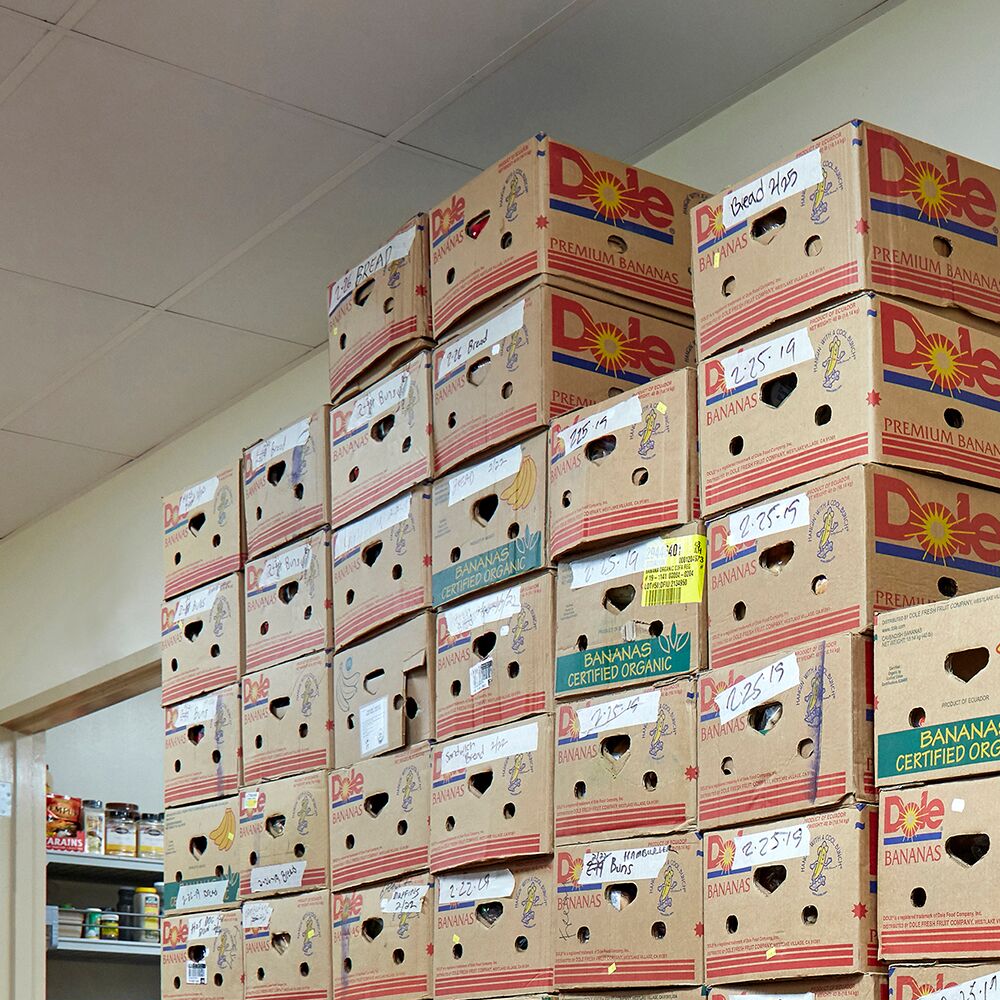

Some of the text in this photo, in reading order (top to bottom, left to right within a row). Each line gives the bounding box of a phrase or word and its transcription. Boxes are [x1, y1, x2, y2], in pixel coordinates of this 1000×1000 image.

[549, 141, 674, 228] Dole
[731, 168, 798, 217] Bread 2/25
[866, 128, 997, 229] Dole
[432, 196, 466, 236] Dole
[551, 237, 679, 284] PREMIUM BANANAS
[873, 246, 941, 274] PREMIUM
[552, 293, 676, 376] Dole
[706, 394, 757, 426] BANANAS
[884, 418, 954, 447] PREMIUM
[455, 546, 510, 577] BANANAS
[712, 559, 756, 590] BANANAS
[441, 556, 526, 599] CERTIFIED ORGANIC
[584, 643, 651, 667] BANANAS
[568, 656, 672, 687] CERTIFIED ORGANIC
[701, 717, 745, 742] BANANAS
[558, 746, 597, 764] BANANAS
[897, 747, 966, 772] CERTIFIED
[332, 769, 364, 802] Dole
[332, 805, 362, 825] BANANAS
[884, 791, 945, 838] Dole
[885, 845, 941, 866] BANANAS
[708, 878, 750, 900] BANANAS
[163, 921, 187, 945] Dole
[438, 912, 474, 929] BANANAS
